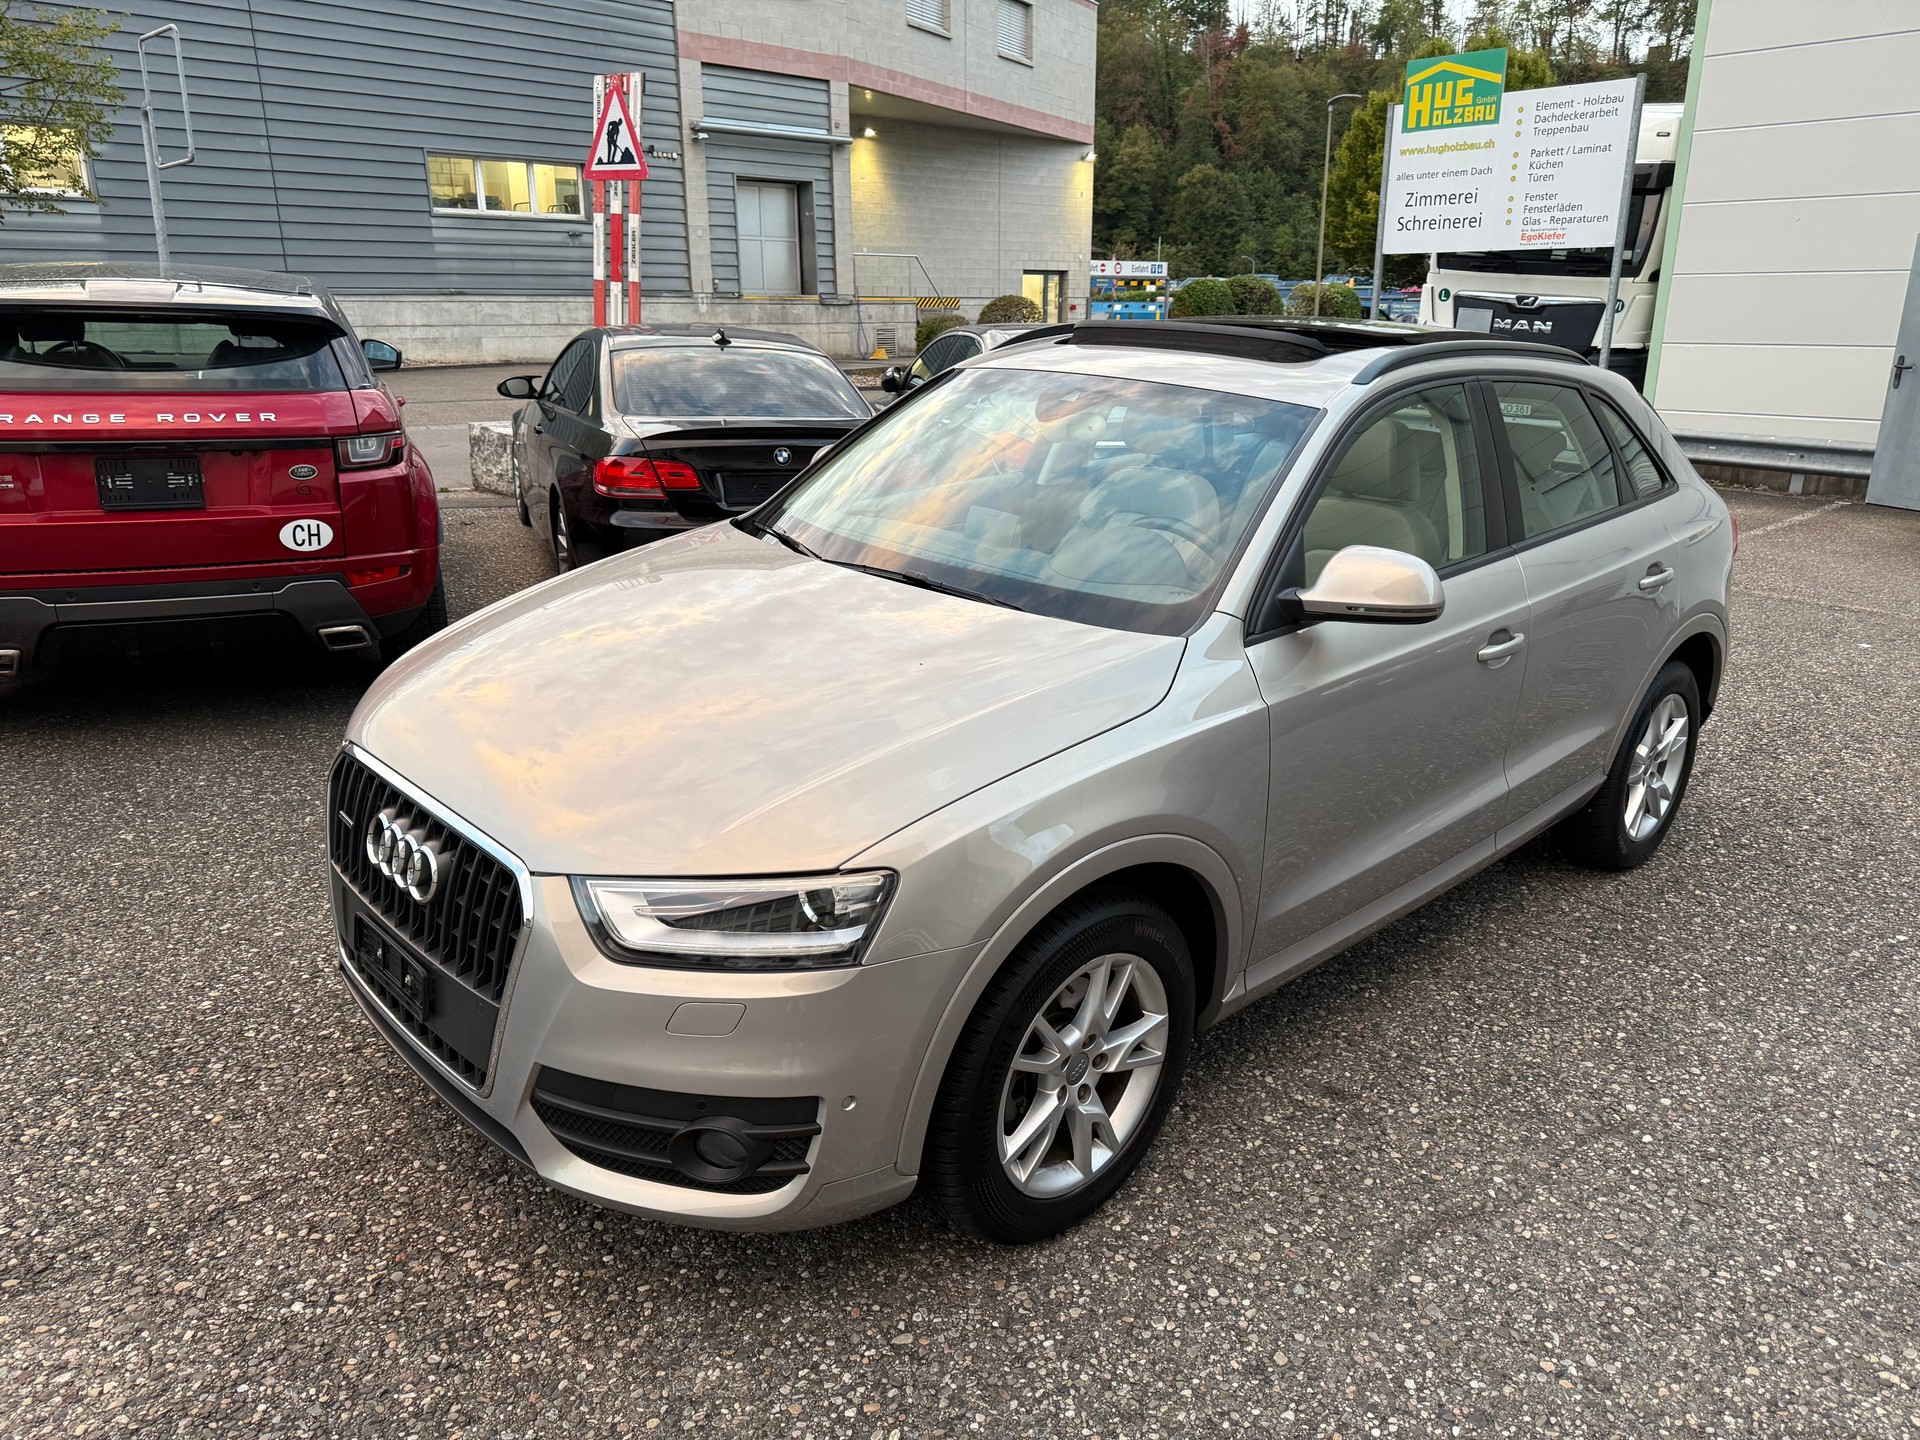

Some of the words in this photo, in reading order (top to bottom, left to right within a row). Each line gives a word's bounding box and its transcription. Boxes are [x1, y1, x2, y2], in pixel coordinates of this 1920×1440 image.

[1476, 95, 1497, 104] GmbH
[1535, 99, 1574, 111] Element
[1583, 94, 1625, 106] Holzbau
[1534, 106, 1619, 124] Dachdeckerarbeit
[1533, 123, 1589, 137] Treppenbau
[1399, 138, 1495, 156] www.hugholzbau.ch
[1530, 147, 1564, 158] Parkett
[1572, 143, 1612, 155] Laminat
[1528, 160, 1564, 170] Küchen
[1396, 172, 1415, 181] alles
[1416, 171, 1439, 180] unter
[1441, 168, 1468, 178] einem
[1470, 166, 1493, 176] Dach
[1528, 173, 1555, 182] Türen
[1404, 187, 1479, 208] Zimmerei
[1524, 192, 1558, 202] Fenster
[1523, 202, 1583, 214] Fensterläden
[1397, 211, 1483, 232] Schreinerei
[1522, 216, 1541, 226] Glas
[1549, 214, 1609, 226] Reparaturen
[1520, 231, 1567, 242] EgoKiefer
[1493, 318, 1553, 334] MAN
[0, 413, 127, 424] RANGE
[156, 413, 278, 424] ROVER
[292, 523, 321, 547] CH
